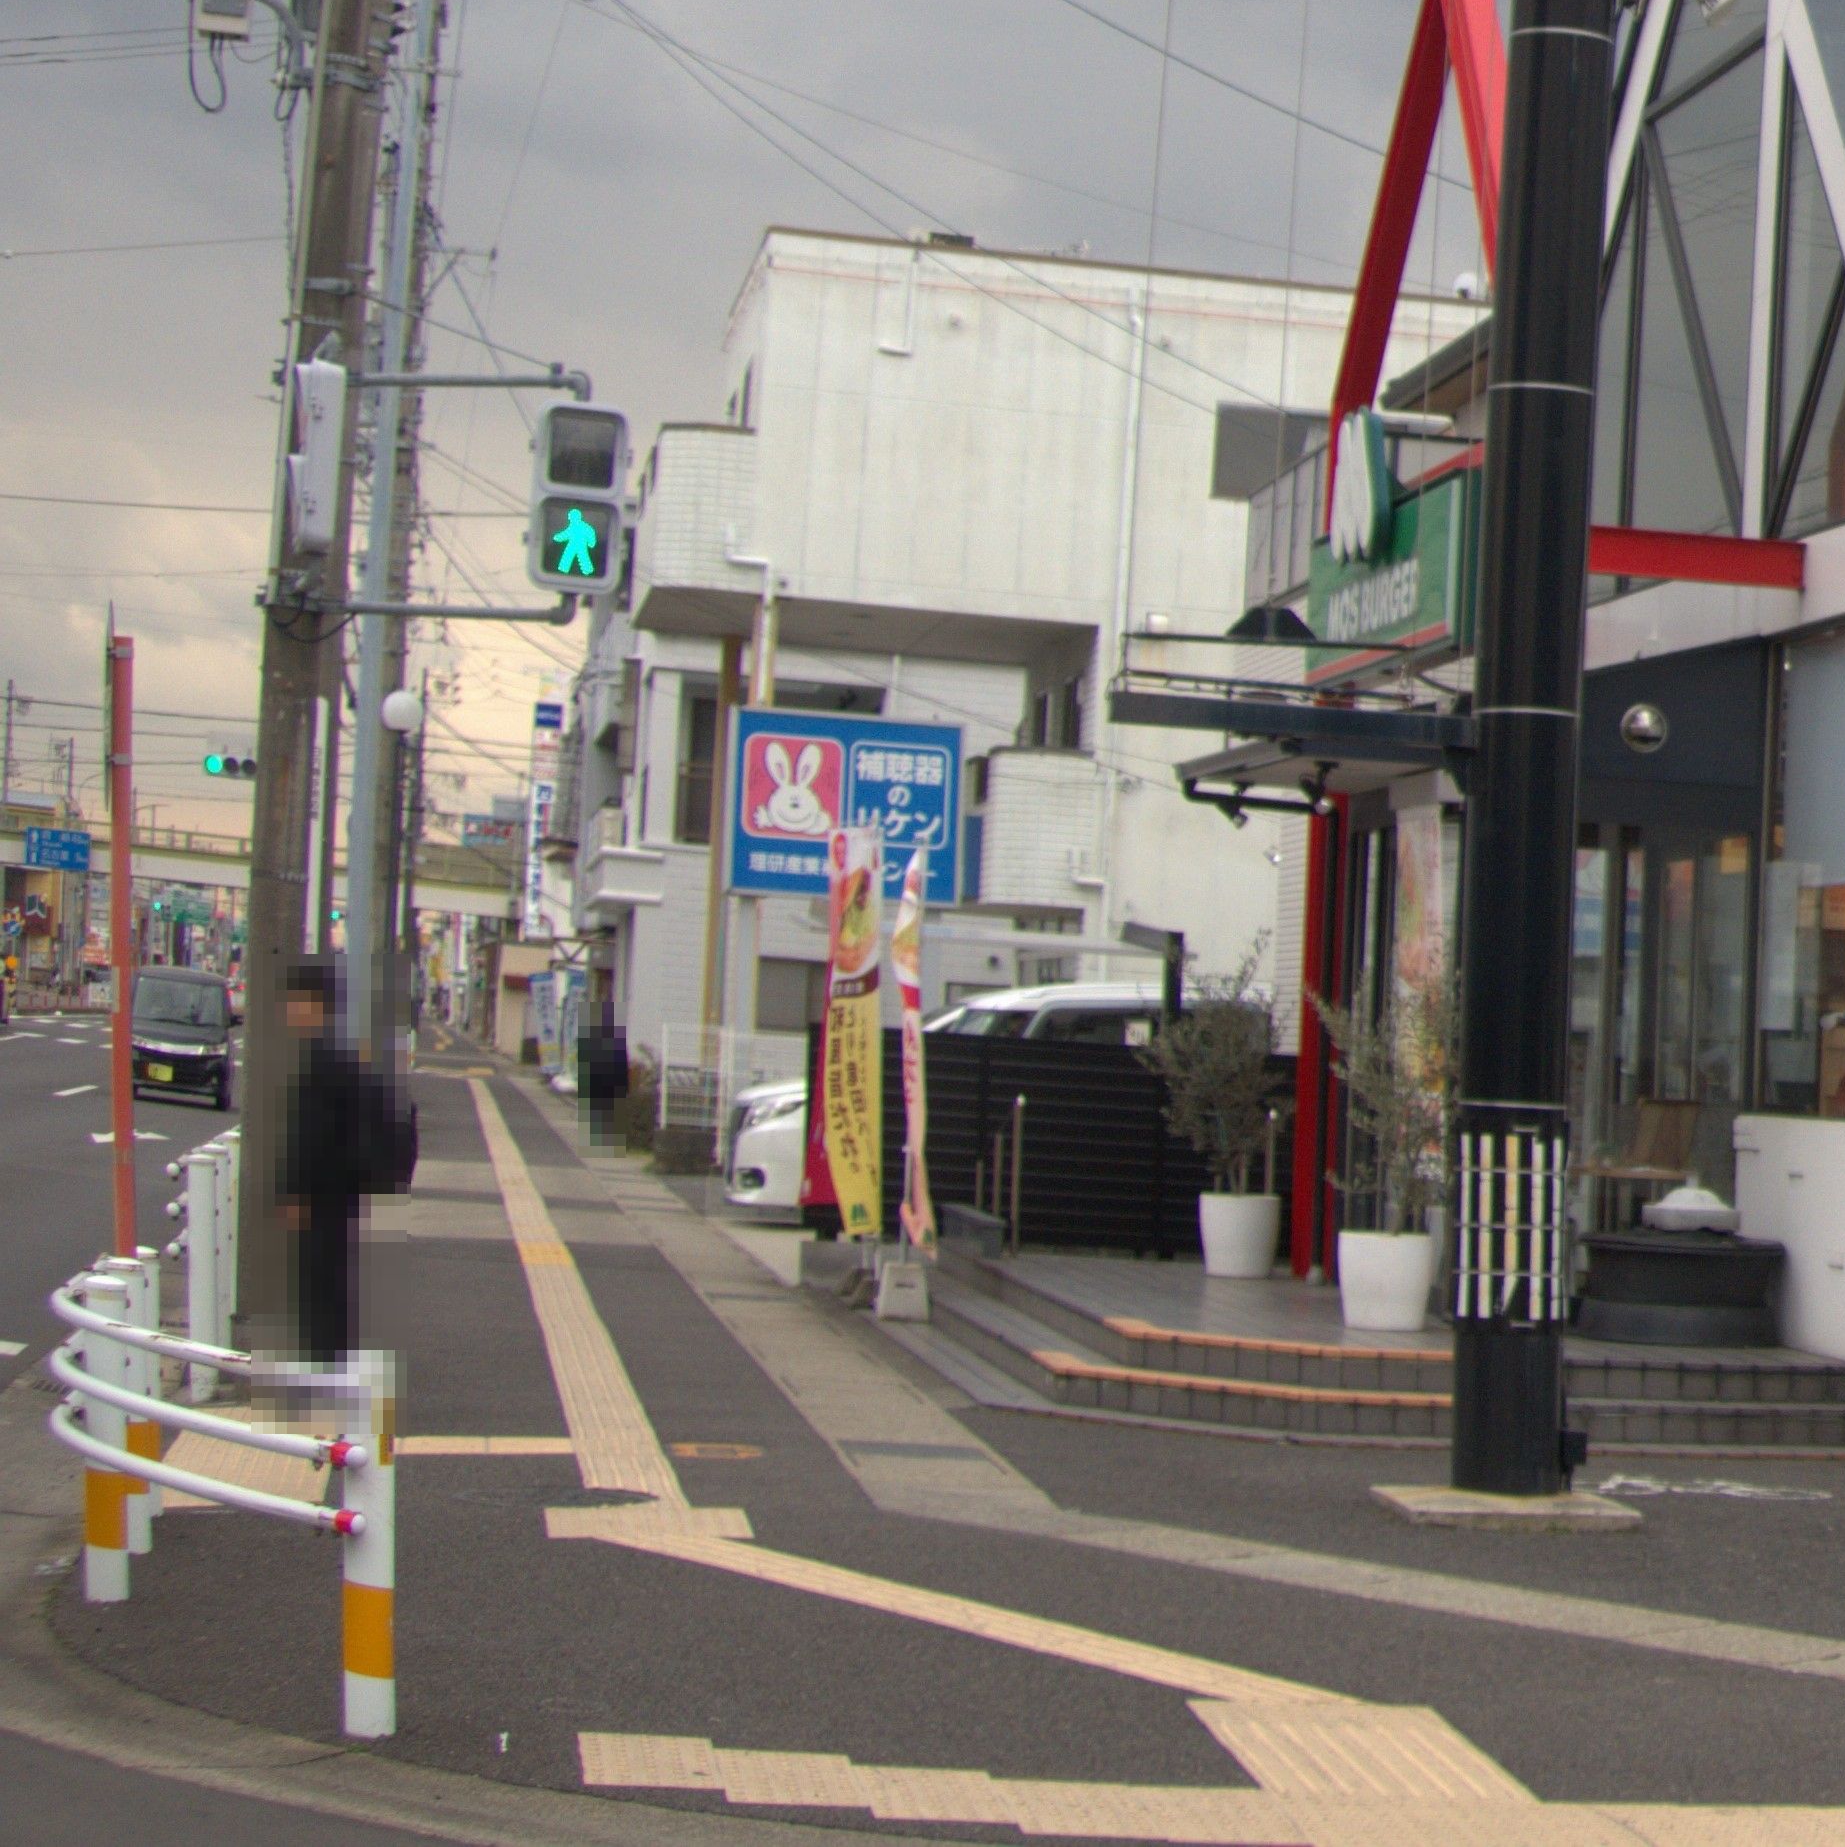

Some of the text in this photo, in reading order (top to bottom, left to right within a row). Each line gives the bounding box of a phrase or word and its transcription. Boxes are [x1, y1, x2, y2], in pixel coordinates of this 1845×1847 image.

[1326, 557, 1418, 642] MOS BURGER
[887, 784, 912, 807] の
